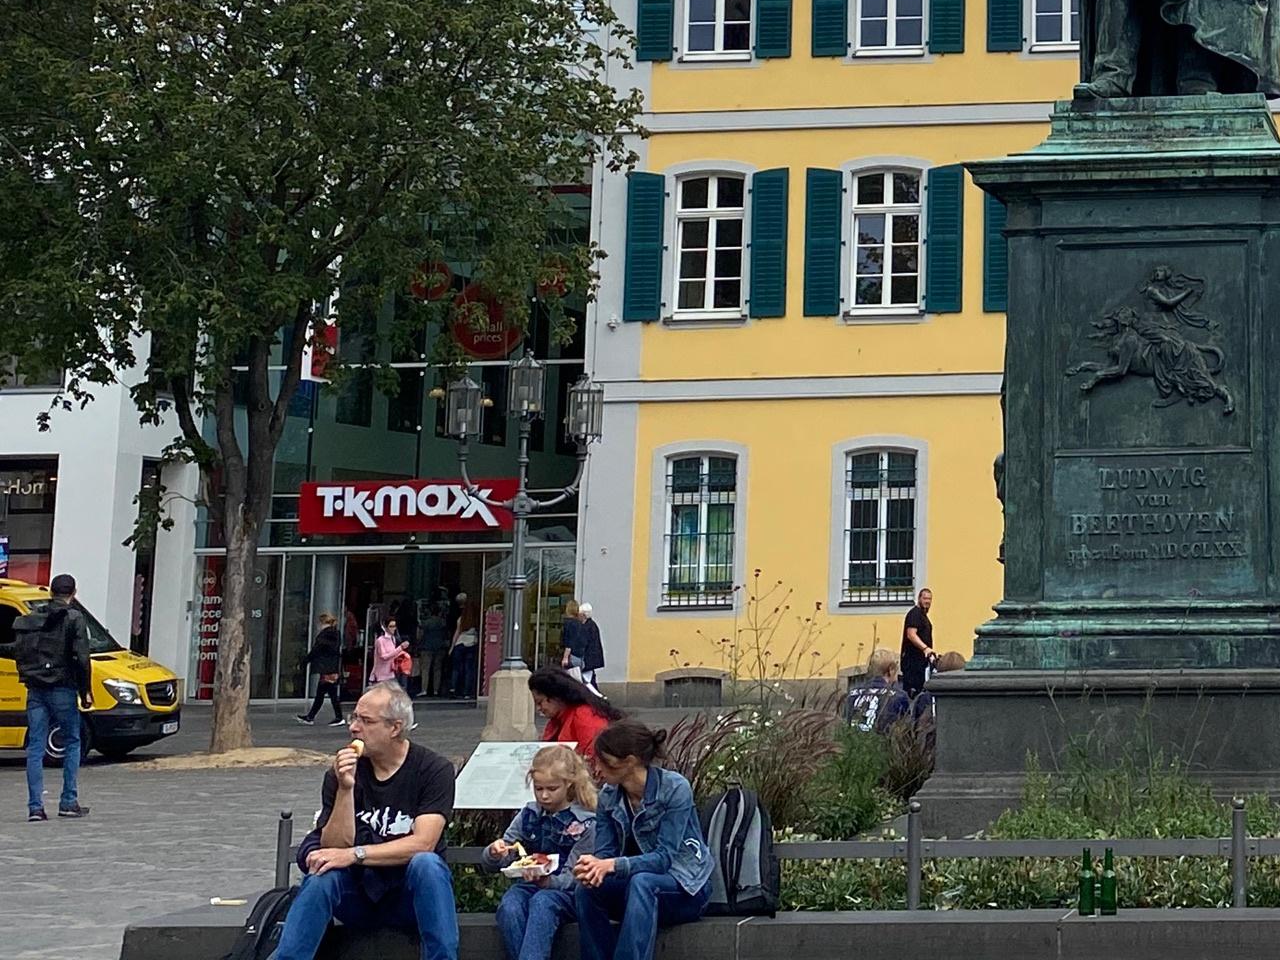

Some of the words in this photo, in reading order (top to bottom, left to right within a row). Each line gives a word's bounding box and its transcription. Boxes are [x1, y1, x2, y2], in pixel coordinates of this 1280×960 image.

[1098, 466, 1208, 489] LUDWIG
[195, 594, 222, 605] Dam
[193, 621, 219, 632] Kind
[192, 637, 219, 646] Herr
[192, 650, 218, 660] Hom
